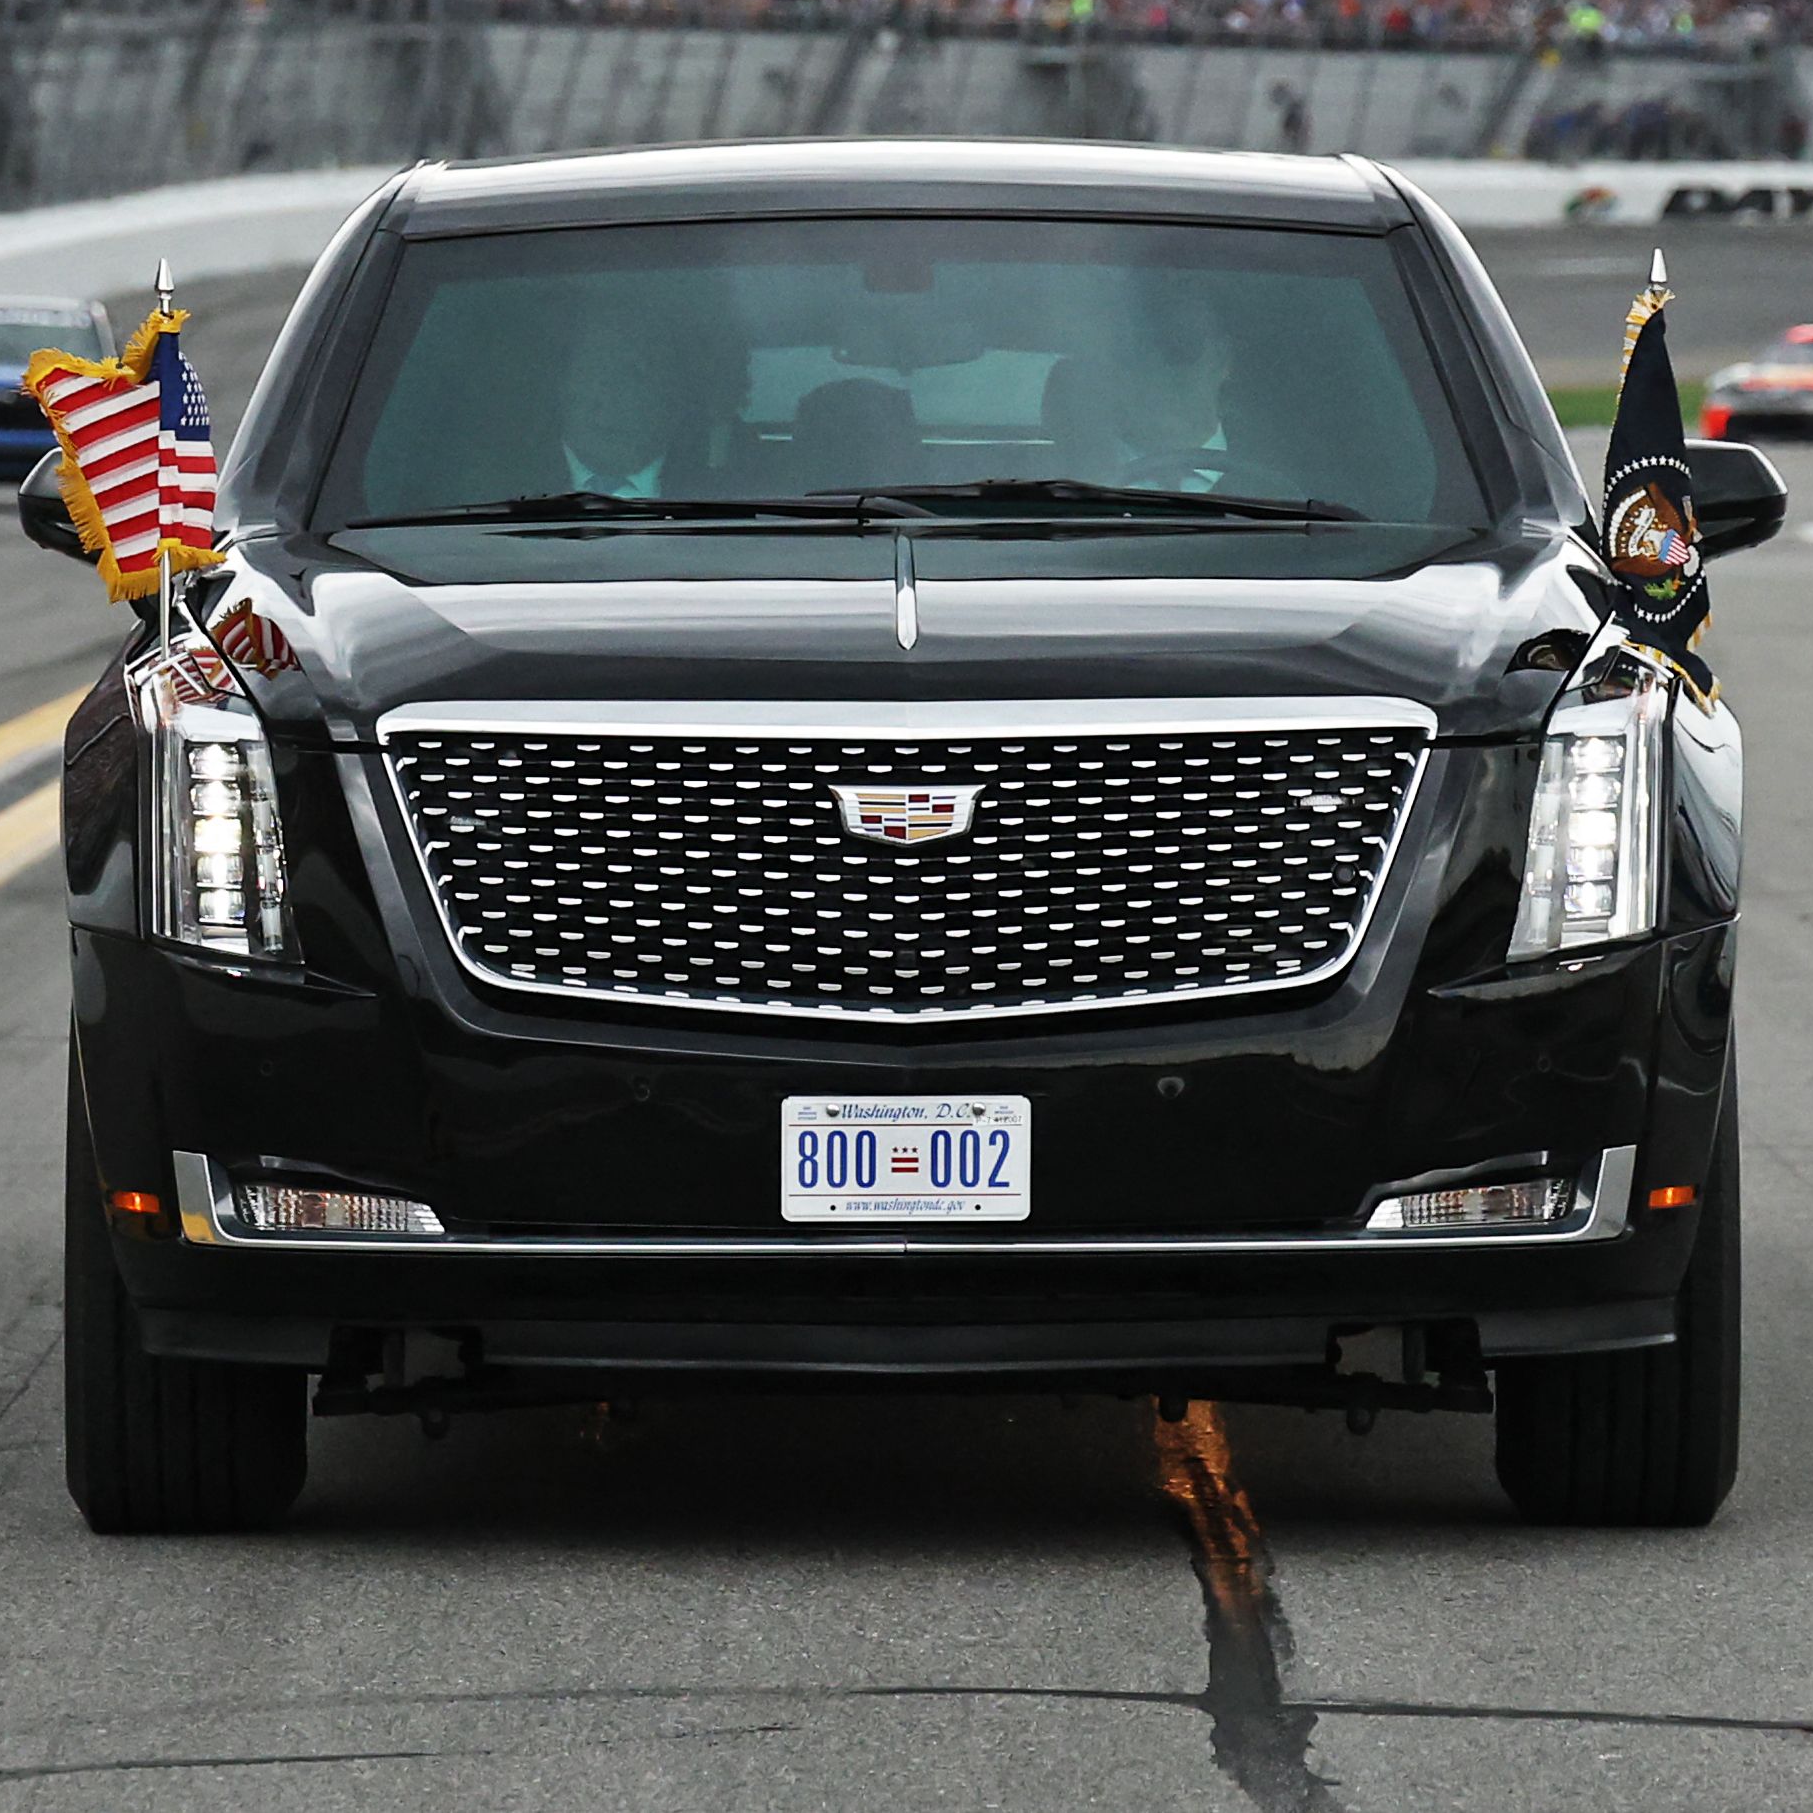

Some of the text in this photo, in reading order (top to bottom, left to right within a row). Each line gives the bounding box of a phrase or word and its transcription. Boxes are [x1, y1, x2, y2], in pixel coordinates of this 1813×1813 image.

[935, 1102, 971, 1119] D.C.
[797, 1128, 1011, 1189] 800 002
